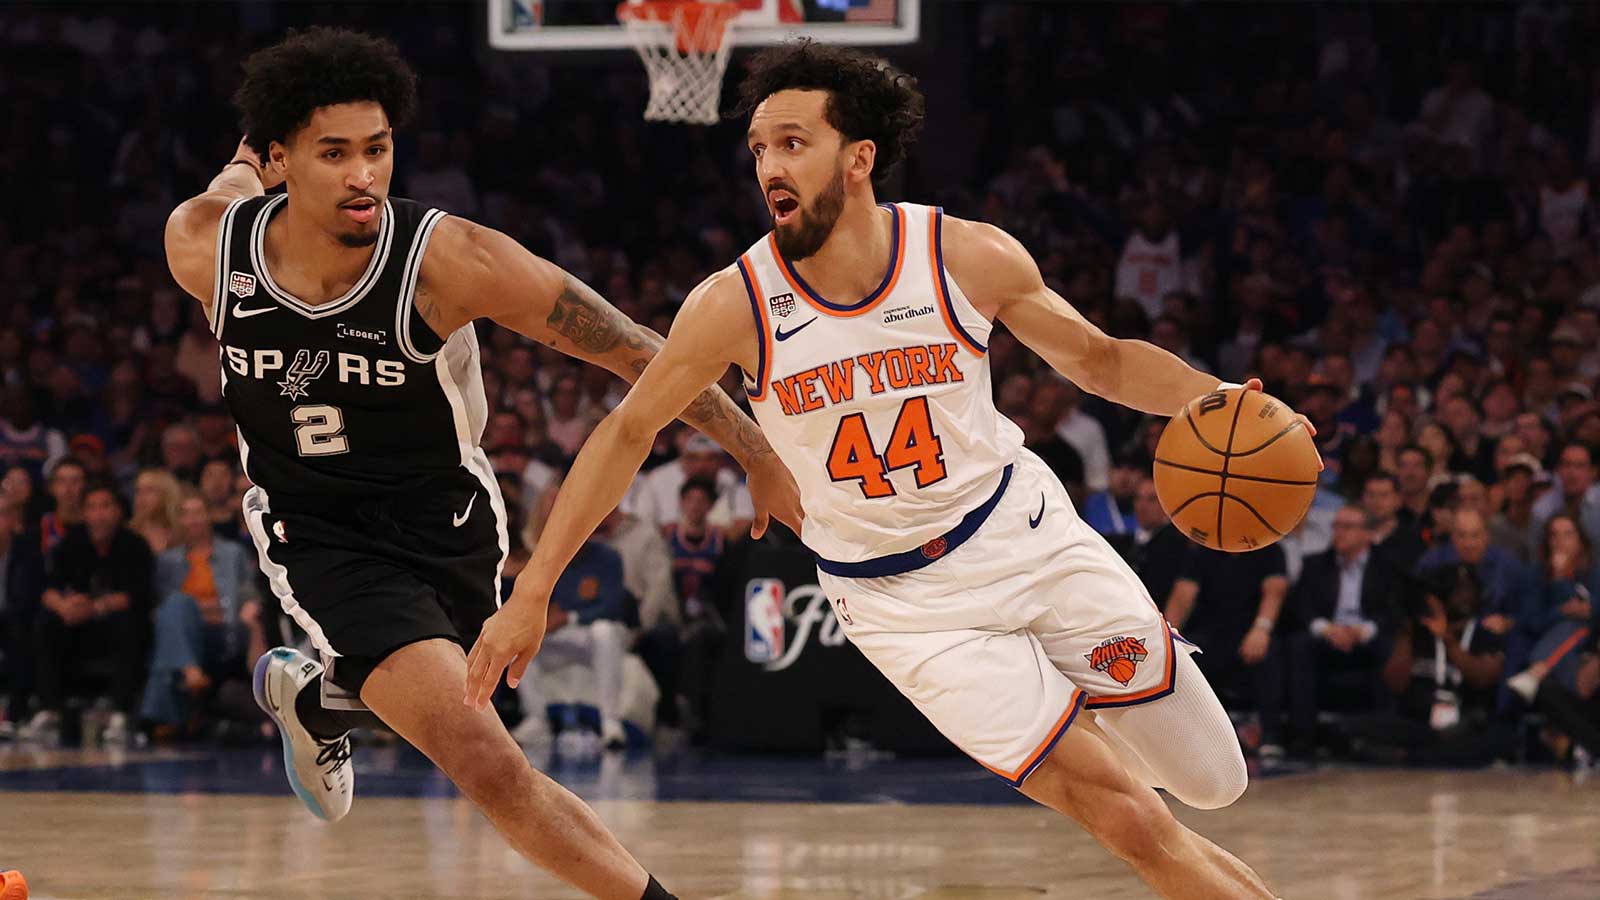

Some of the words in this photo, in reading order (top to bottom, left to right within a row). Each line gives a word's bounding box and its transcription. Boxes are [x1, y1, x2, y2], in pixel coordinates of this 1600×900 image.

[233, 274, 252, 284] USA
[771, 295, 793, 305] USA
[773, 304, 795, 316] 250
[883, 313, 904, 323] abu
[904, 304, 935, 319] dhabi
[343, 328, 380, 341] LEDGER
[226, 345, 406, 401] SPURS
[772, 357, 855, 416] NEW
[858, 343, 965, 395] YORK
[290, 404, 350, 457] 2
[826, 395, 948, 499] 44
[1090, 637, 1149, 670] KNICKS
